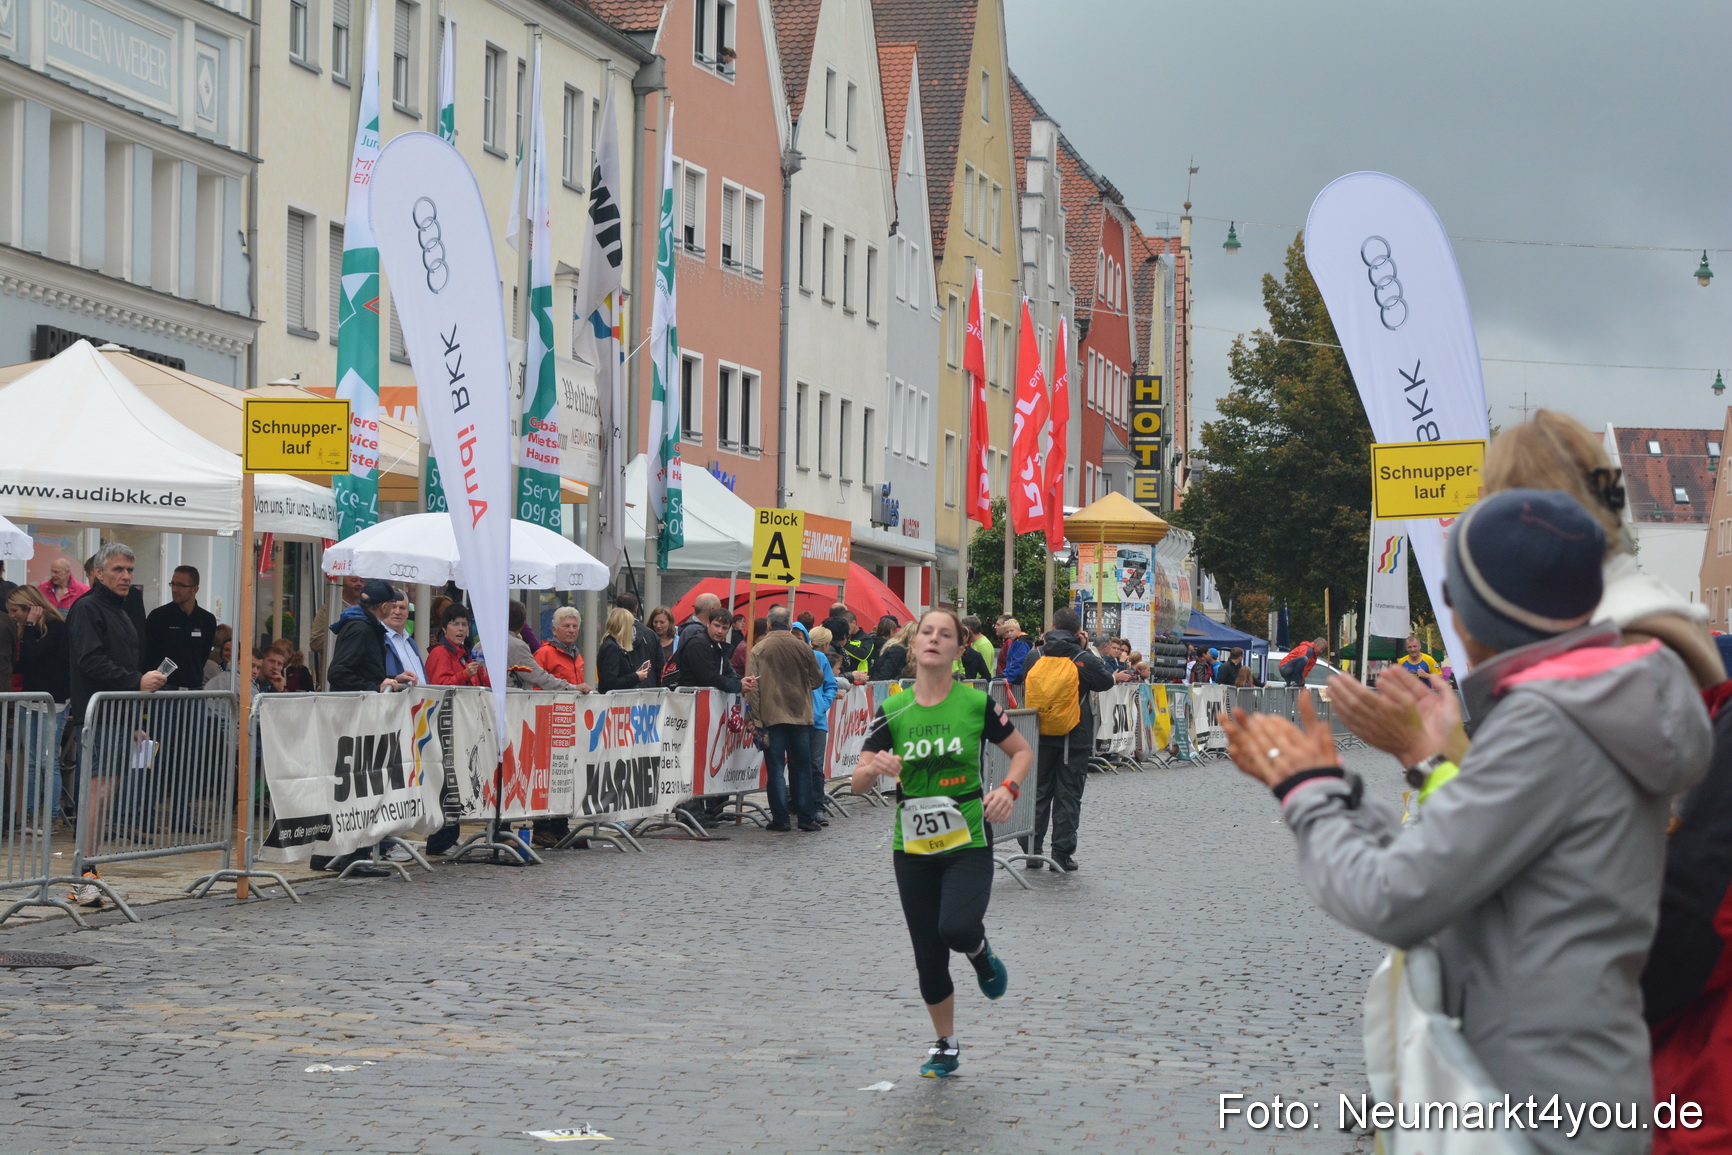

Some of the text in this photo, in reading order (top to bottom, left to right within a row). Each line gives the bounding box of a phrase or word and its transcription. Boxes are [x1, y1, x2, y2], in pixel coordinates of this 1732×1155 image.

[50, 0, 169, 90] BRILLEN WEBER
[1398, 357, 1441, 442] BKK
[251, 419, 343, 438] Schnupper-
[282, 440, 312, 454] lauf
[1380, 464, 1479, 481] Schnupper-
[0, 484, 187, 507] www.audibkk.de
[1414, 484, 1447, 500] lauf
[253, 495, 269, 513] Von
[312, 502, 328, 520] Audi
[760, 510, 798, 526] Block
[762, 531, 790, 569] A
[909, 723, 951, 738] FÜRTH
[903, 736, 964, 761] 2014
[939, 775, 967, 787] OBI
[913, 811, 950, 836] 251
[928, 840, 945, 850] Eva
